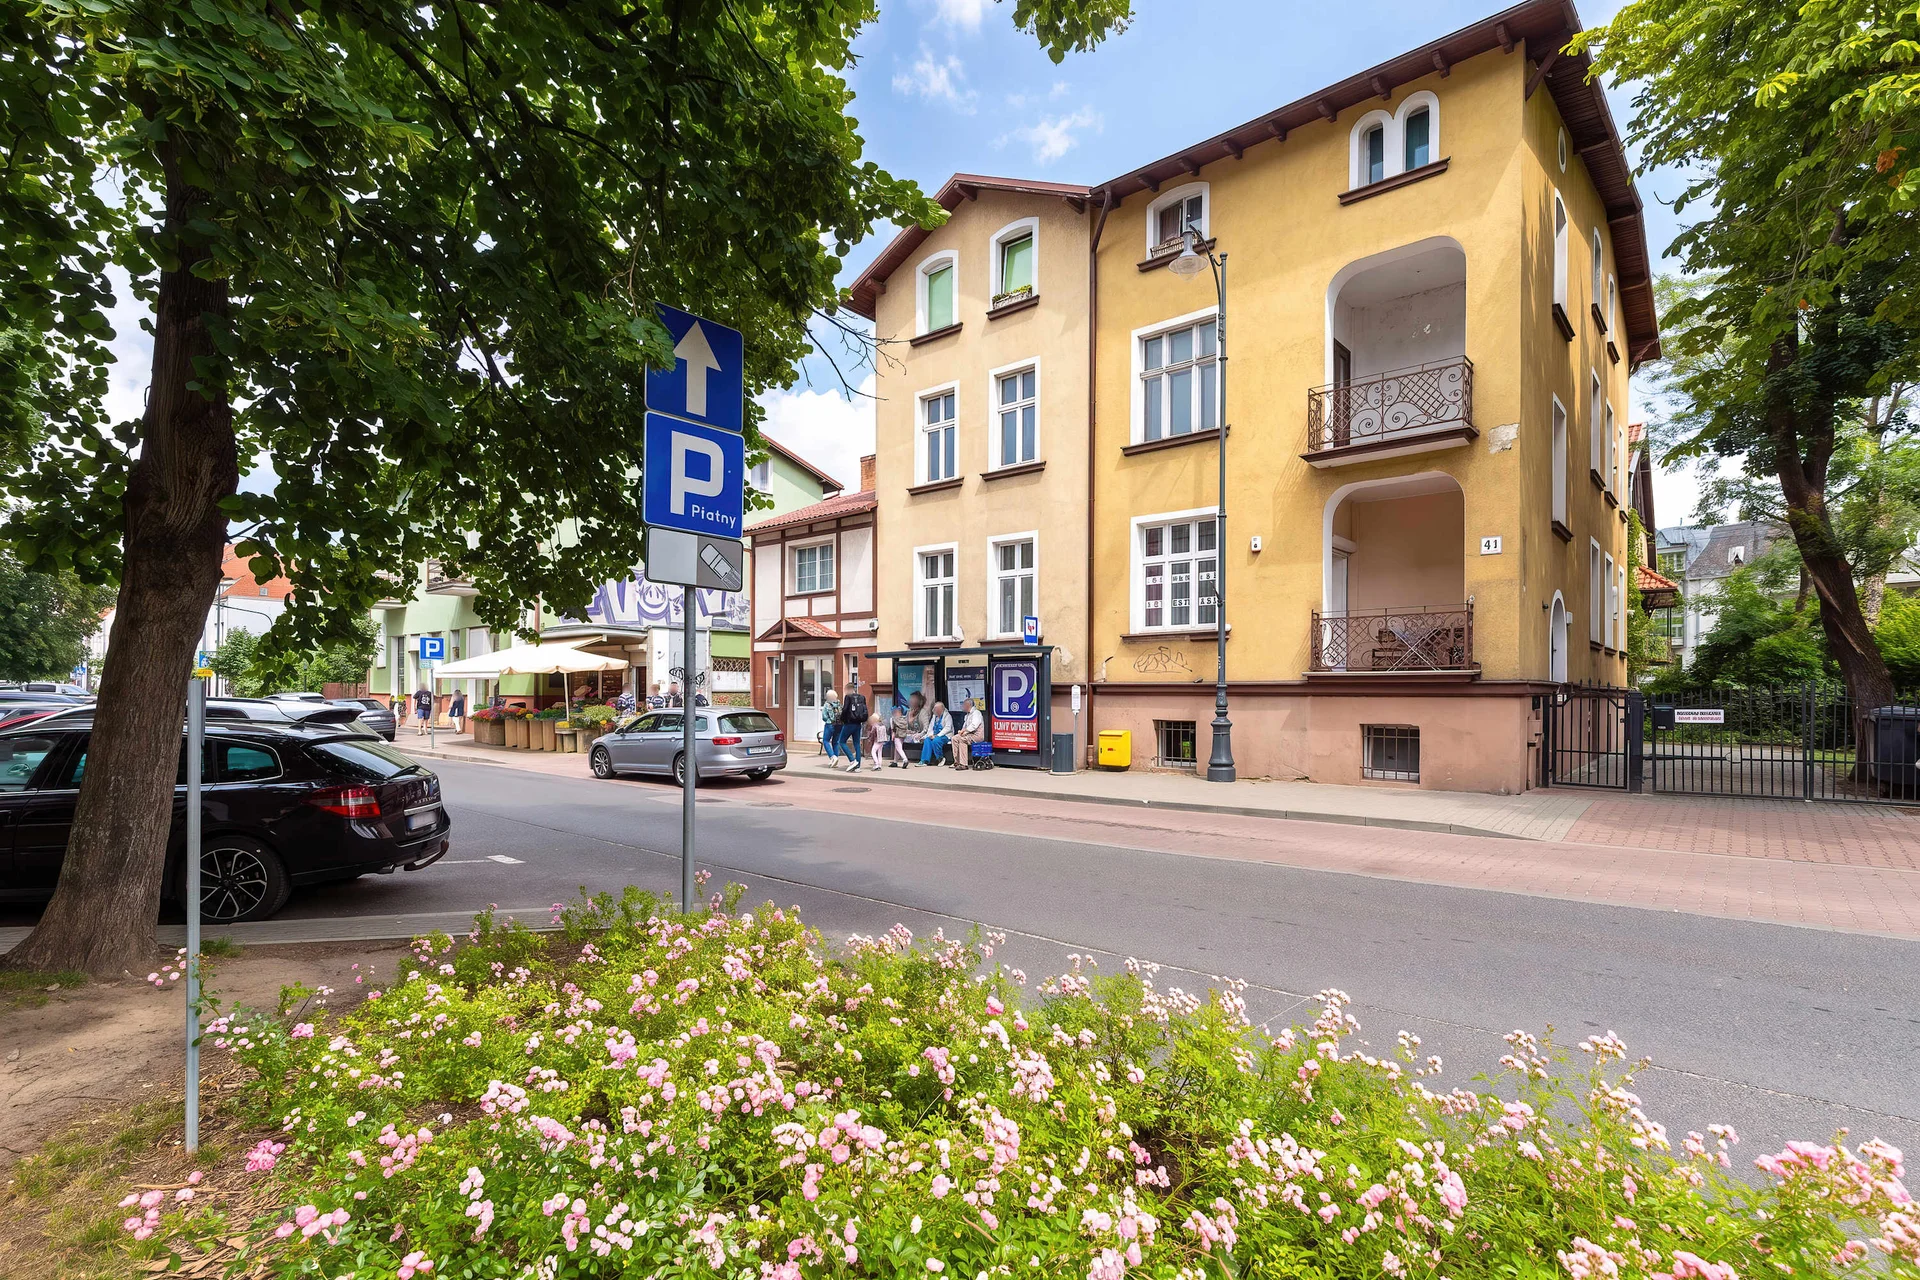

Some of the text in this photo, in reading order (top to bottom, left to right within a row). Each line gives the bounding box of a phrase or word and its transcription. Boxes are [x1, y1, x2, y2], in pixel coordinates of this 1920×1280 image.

[670, 430, 724, 516] P
[691, 504, 736, 529] Piatny
[1484, 539, 1498, 550] 41
[425, 640, 440, 658] P
[1001, 670, 1029, 713] P
